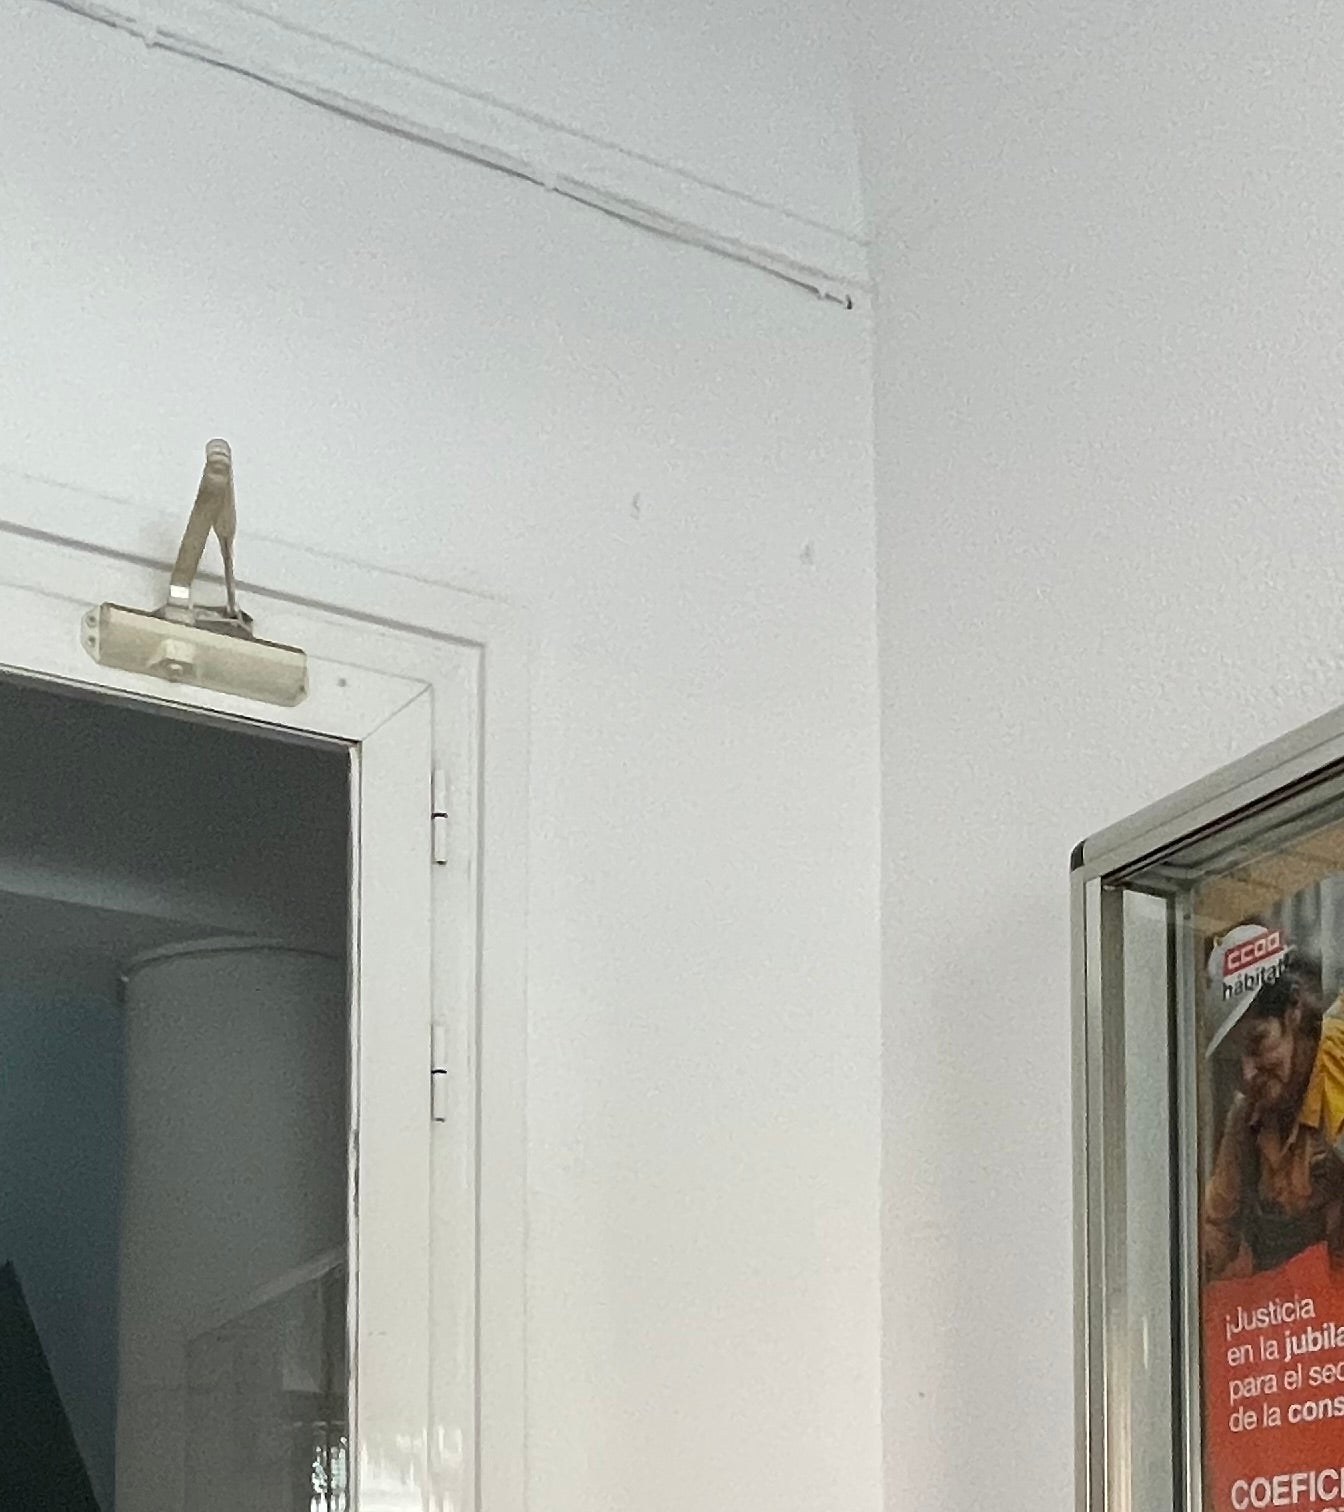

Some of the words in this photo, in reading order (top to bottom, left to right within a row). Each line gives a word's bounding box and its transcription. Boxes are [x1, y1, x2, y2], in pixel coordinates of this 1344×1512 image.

[1227, 931, 1280, 969] CCOO
[1226, 1296, 1316, 1340] ¡Justicia
[1227, 1342, 1254, 1366] en
[1260, 1336, 1279, 1361] la
[1229, 1369, 1277, 1404] para
[1284, 1362, 1302, 1390] el
[1229, 1406, 1257, 1433] de
[1262, 1402, 1281, 1427] la
